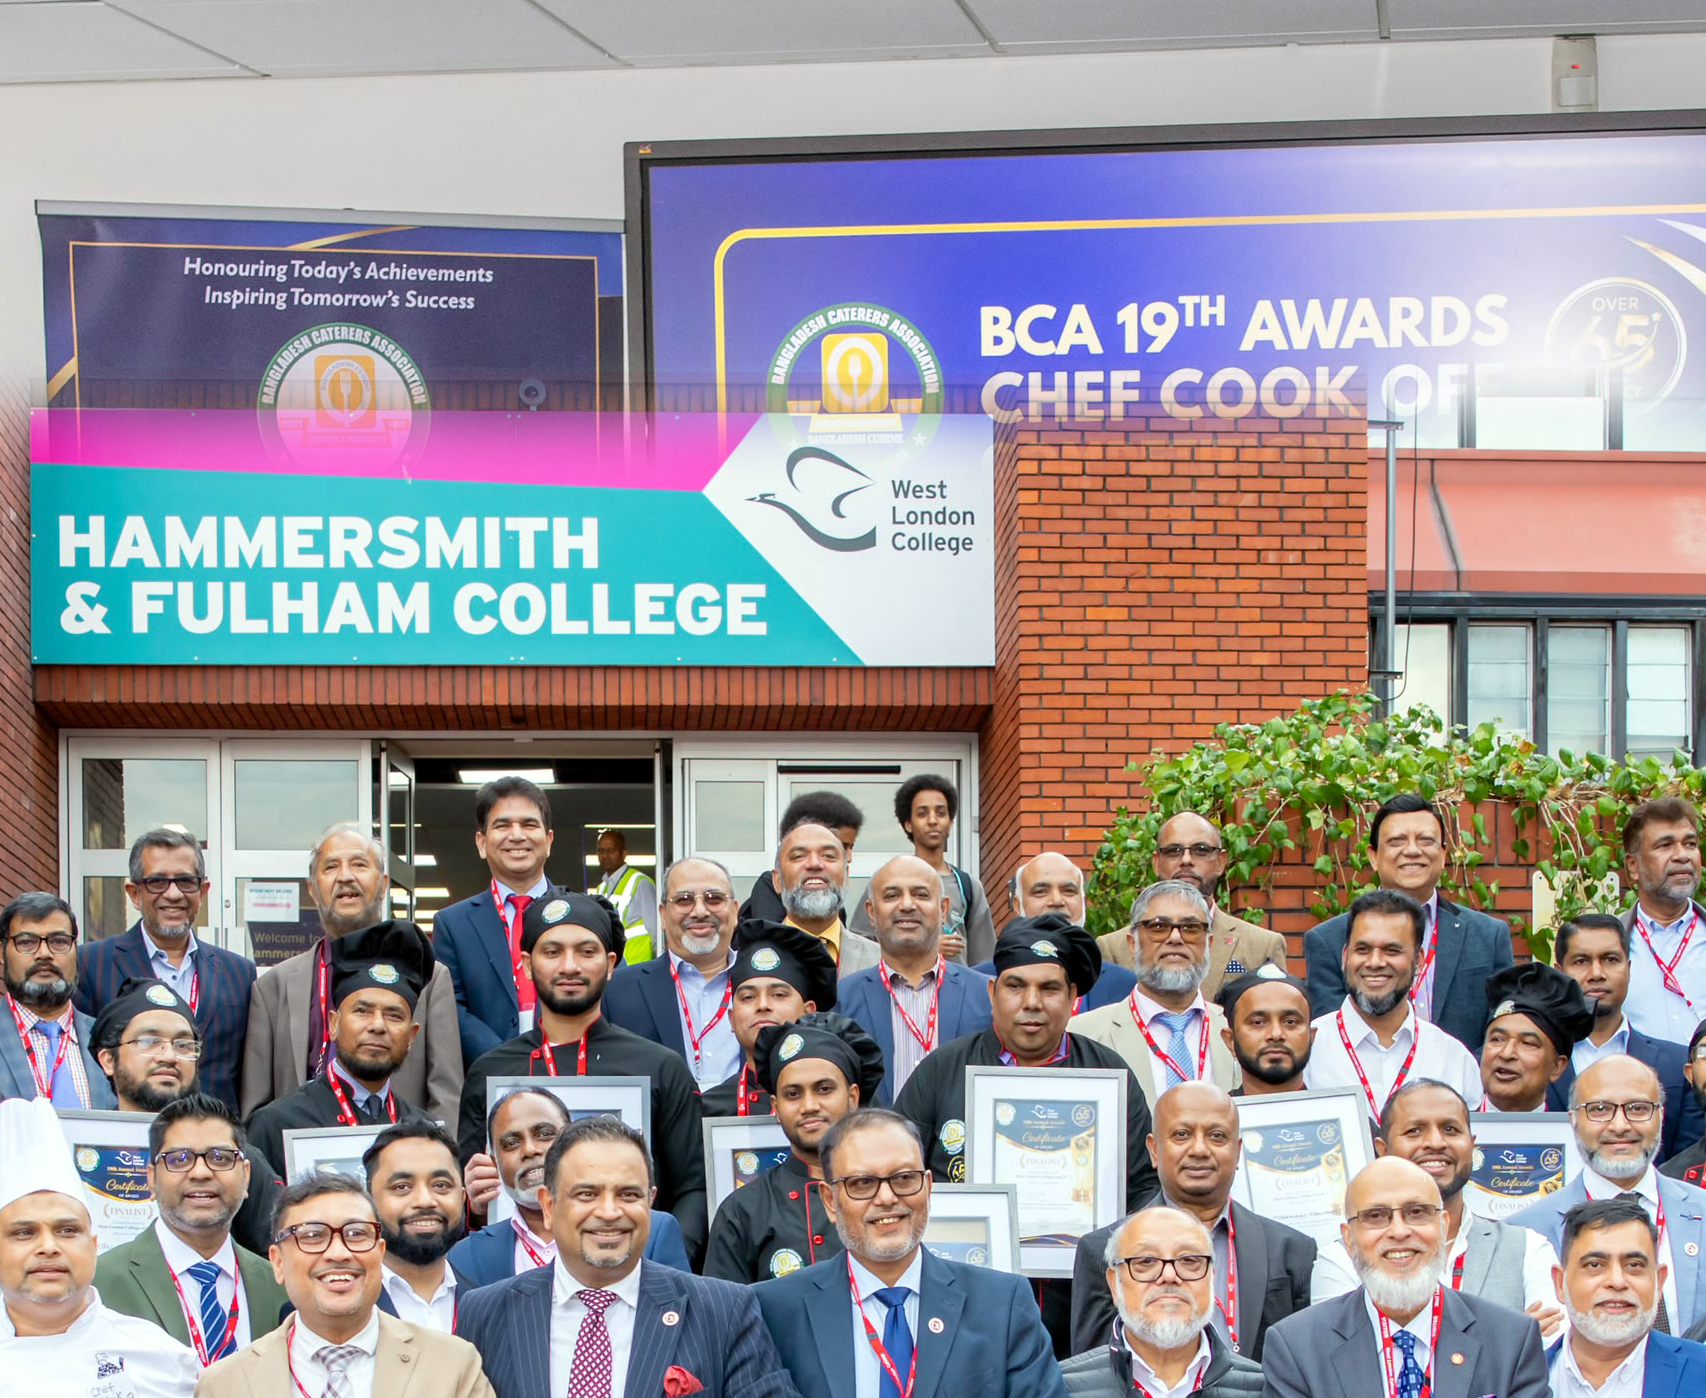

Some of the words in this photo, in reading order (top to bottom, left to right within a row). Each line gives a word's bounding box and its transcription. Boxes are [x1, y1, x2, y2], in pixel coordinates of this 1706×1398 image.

[183, 257, 288, 283] Honouring
[291, 260, 362, 284] Today's
[365, 262, 494, 284] Achievements
[204, 286, 287, 310] Inspiring
[291, 288, 400, 308] Tomorrow's
[405, 290, 476, 310] Success
[1592, 296, 1640, 312] OVER
[980, 304, 1104, 357] BCA
[1116, 294, 1227, 354] 19TH
[1238, 293, 1510, 352] AWARDS
[261, 334, 313, 405] BANGLADESH
[311, 325, 371, 347] CATERERS
[370, 334, 427, 405] ASSOCIATION
[771, 315, 828, 385] BANGLADESH
[827, 306, 890, 327] CATERERS
[887, 318, 940, 394] ASSOCIATION
[980, 371, 1141, 425] CHEF
[1158, 364, 1362, 421] COOK
[891, 479, 947, 499] West
[891, 505, 975, 525] London
[57, 514, 599, 570] HAMMERSMITH
[891, 531, 974, 556] College
[60, 581, 110, 635] &
[131, 581, 432, 635] FULHAM
[453, 582, 768, 636] COLLEGE
